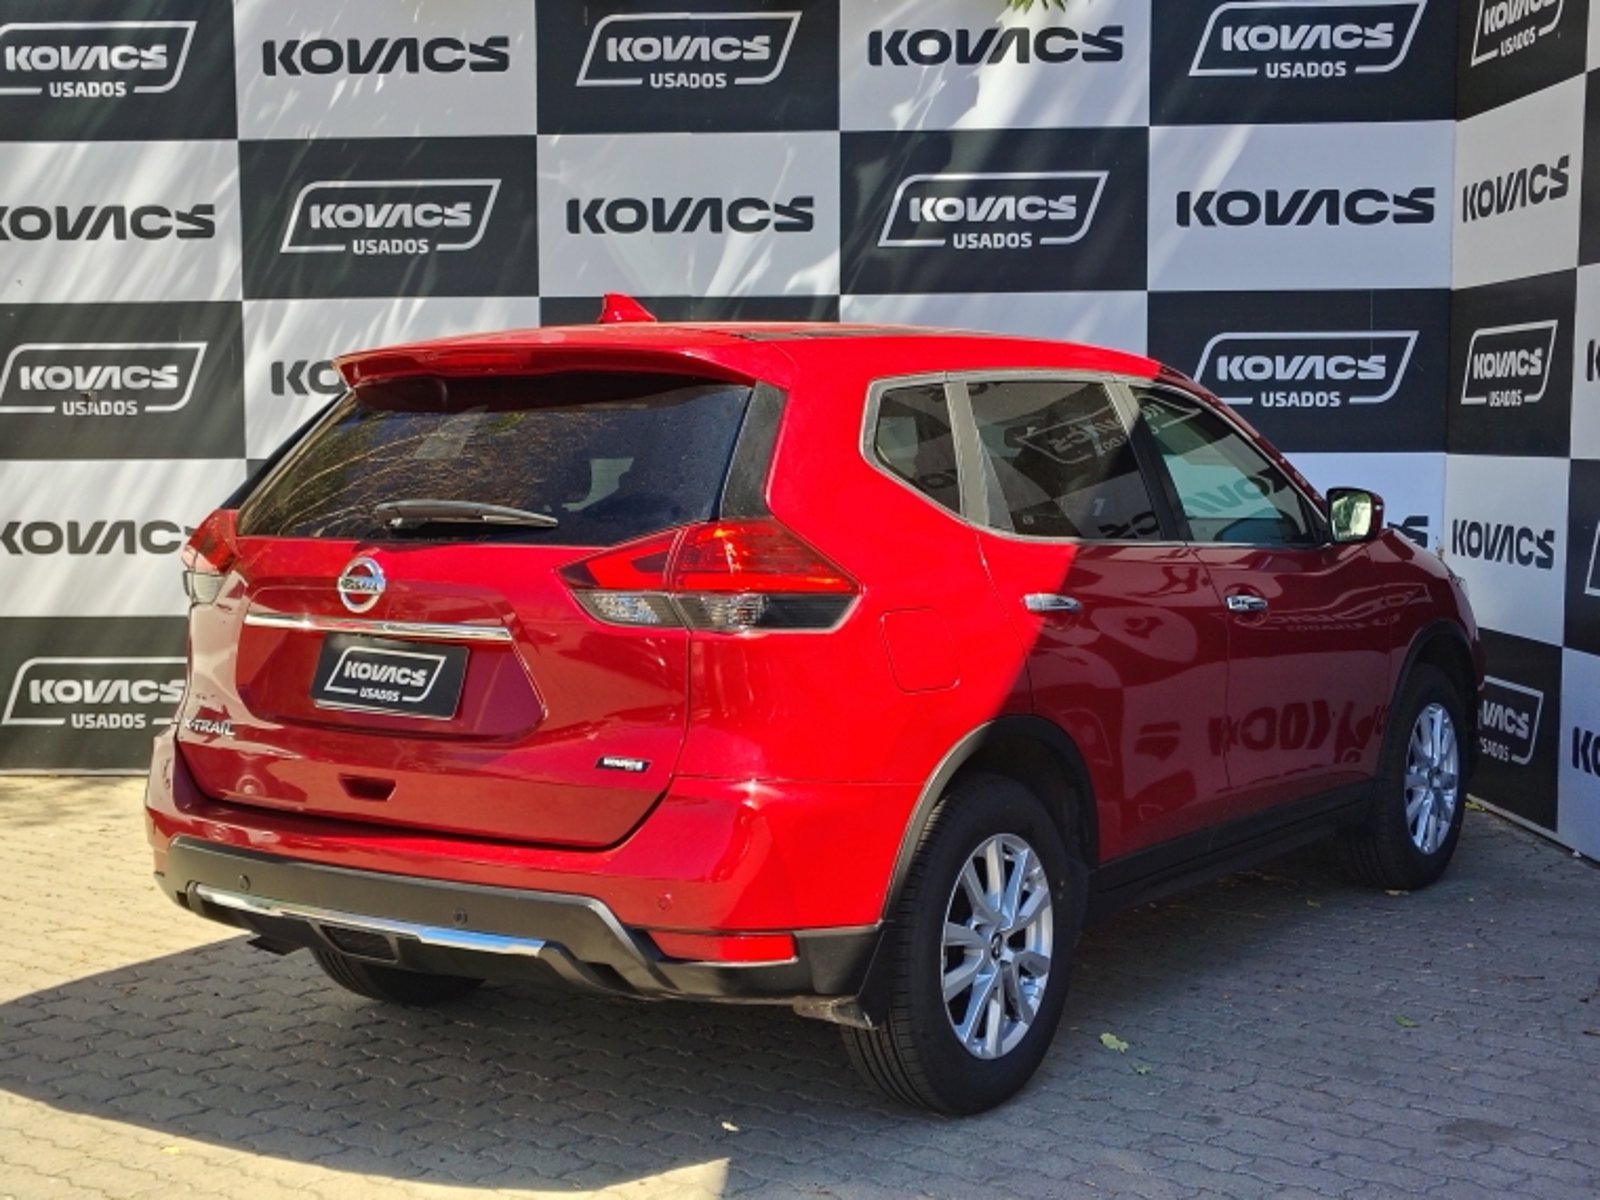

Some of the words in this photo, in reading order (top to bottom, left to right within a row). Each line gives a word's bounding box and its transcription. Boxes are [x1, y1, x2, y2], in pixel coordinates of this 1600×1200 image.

[1483, 0, 1558, 35] KOVAC
[607, 36, 770, 61] KOVACS
[868, 25, 1123, 66] KOVACS
[1222, 23, 1393, 51] KOVACS
[1500, 26, 1537, 57] USADOS
[5, 45, 167, 70] KOVACS
[263, 36, 509, 76] KOVACS
[650, 73, 726, 88] USADOS
[1266, 61, 1346, 78] USADOS
[50, 82, 126, 97] USADOS
[1463, 155, 1569, 222] KOVACS
[311, 203, 471, 228] KOVACS
[567, 197, 814, 234] KOVACS
[910, 196, 1076, 222] KOVACS
[1177, 187, 1435, 226] KOVACS
[0, 204, 215, 240] OVACS
[353, 239, 429, 254] USADOS
[954, 233, 1032, 249] USADOS
[1218, 355, 1385, 380] KOVACS
[1473, 347, 1543, 380] KOVACS
[20, 365, 178, 390] KOVACS
[63, 401, 137, 415] USADOS
[1261, 392, 1340, 407] USADOS
[1489, 389, 1522, 406] USADOS
[0, 521, 190, 555] KOVAC
[1453, 520, 1554, 569] KOVACS
[343, 661, 428, 687] KOVACS
[30, 679, 185, 704] KOVACS
[72, 714, 145, 728] USADOS
[1478, 699, 1530, 740] VACS
[1479, 737, 1510, 762] SADOS
